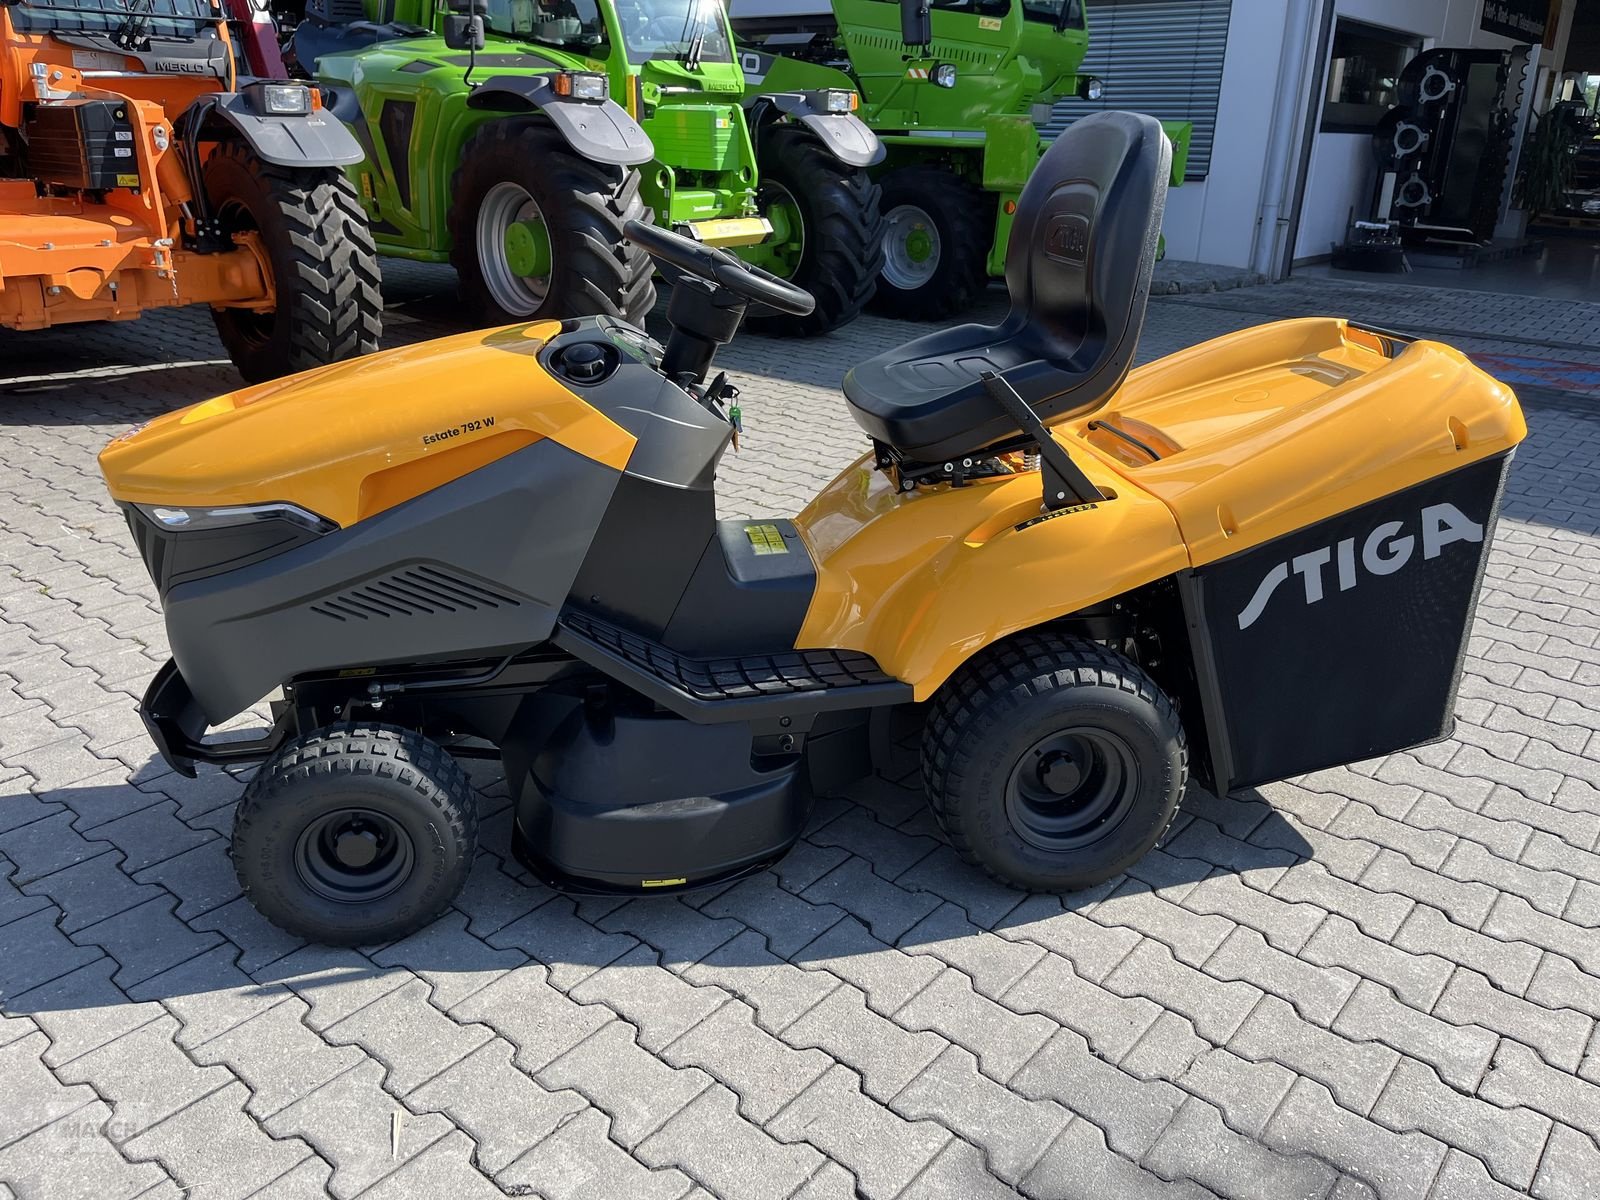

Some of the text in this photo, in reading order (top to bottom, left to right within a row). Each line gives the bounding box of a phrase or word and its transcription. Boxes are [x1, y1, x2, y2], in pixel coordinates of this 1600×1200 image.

[155, 61, 204, 73] MERLO
[708, 82, 735, 91] MERLO
[422, 416, 495, 445] Estate 792 W
[1237, 502, 1483, 630] STIGA
